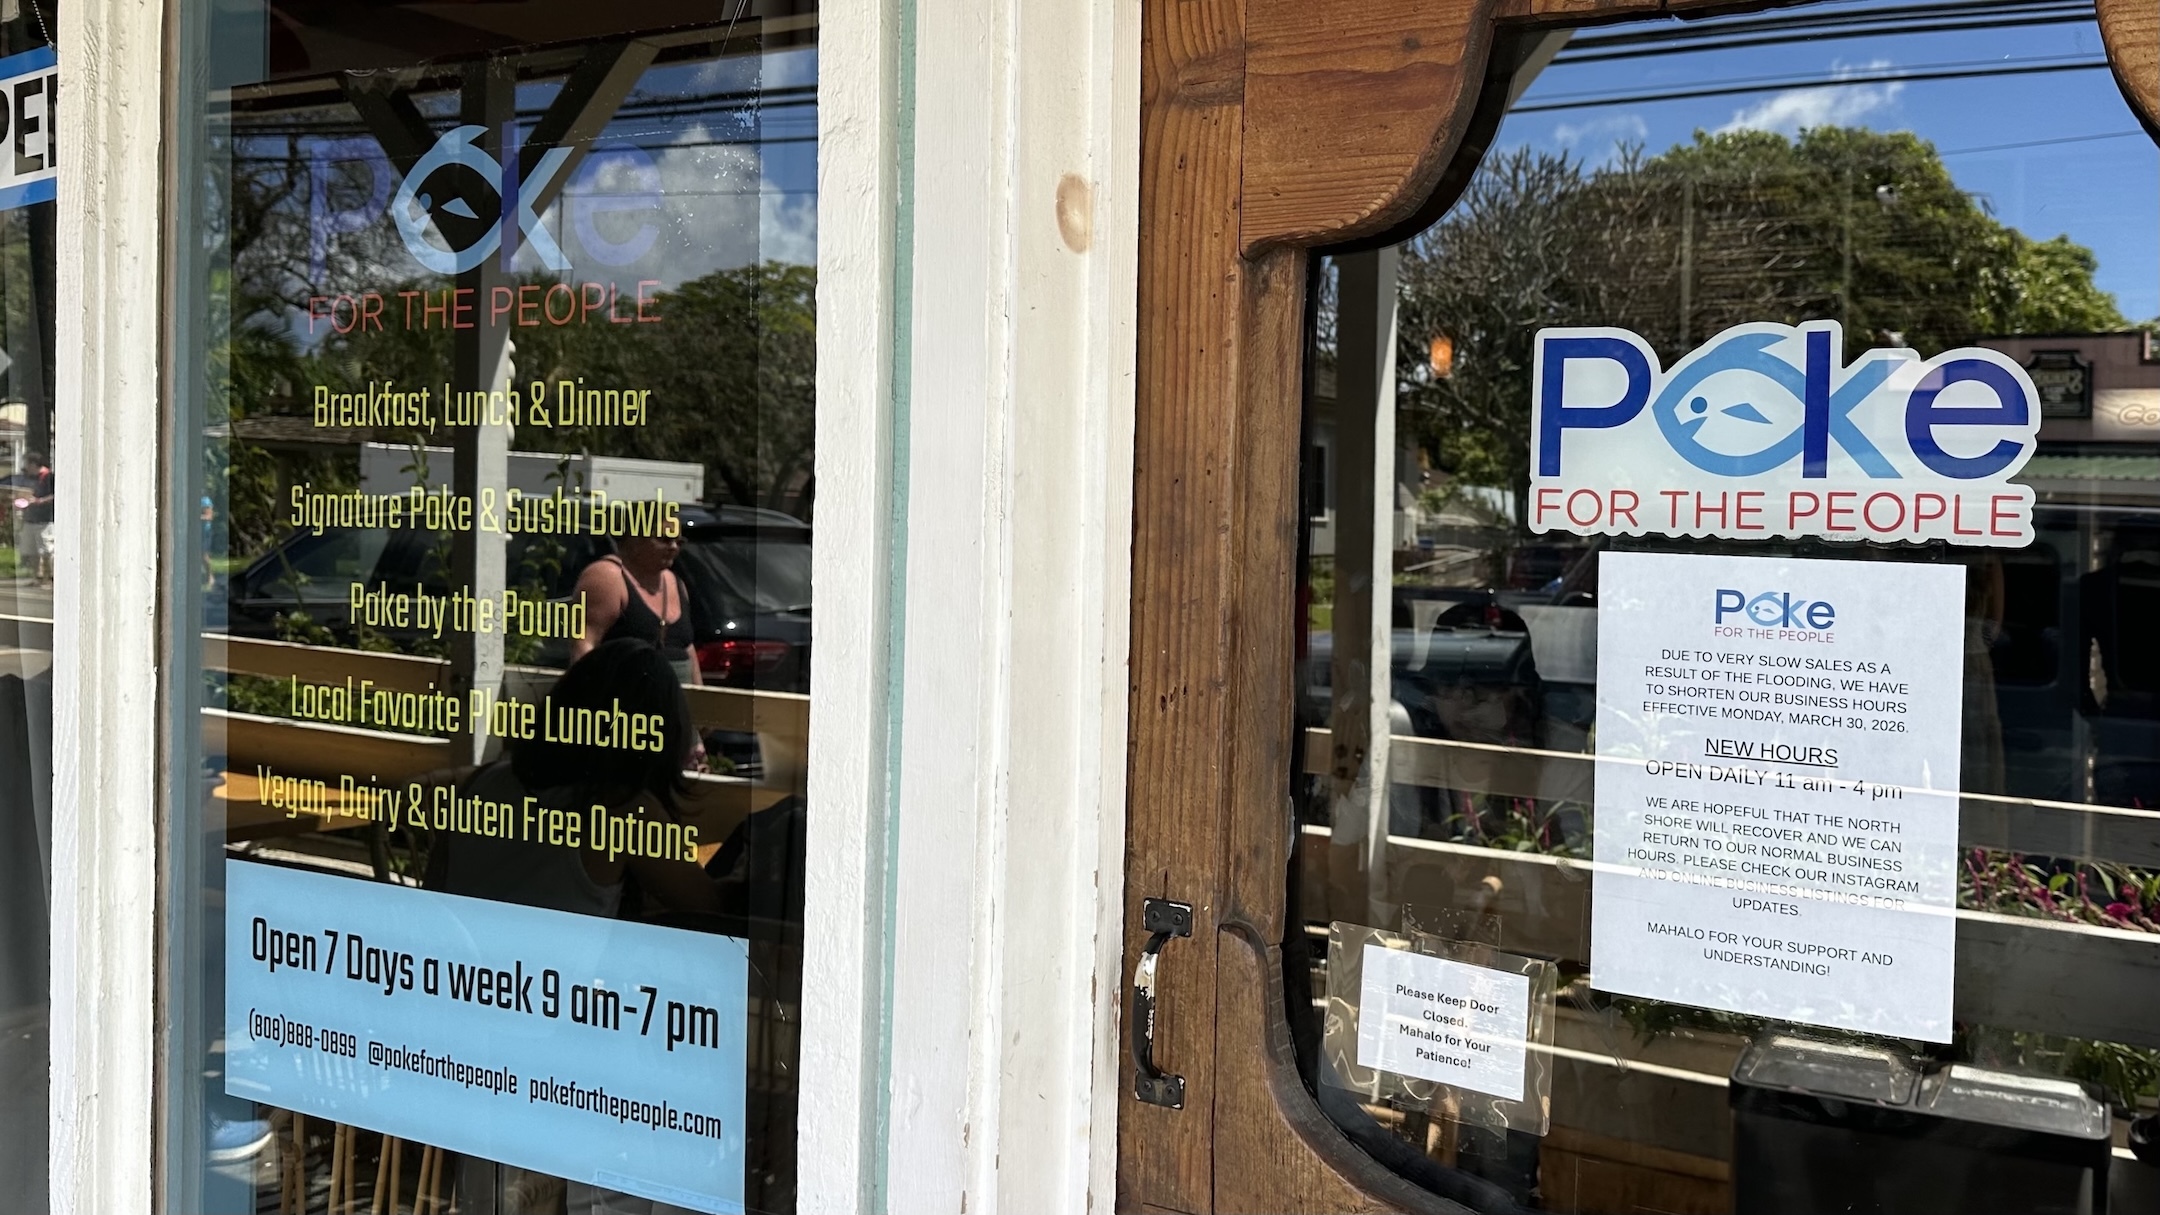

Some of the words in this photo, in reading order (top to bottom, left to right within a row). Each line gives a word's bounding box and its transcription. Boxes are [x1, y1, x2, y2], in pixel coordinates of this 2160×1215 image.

[309, 294, 383, 334] FOR
[398, 289, 474, 329] THE
[491, 280, 662, 326] PEOPLE
[314, 381, 436, 434] Breakfast,
[444, 382, 520, 426] Lunch
[530, 381, 553, 428] &
[558, 378, 651, 426] Dinner
[1539, 331, 2029, 480] Poke
[291, 483, 401, 536] Signature
[411, 485, 471, 531] Poke
[480, 487, 502, 534] &
[507, 485, 579, 535] Sushi
[590, 488, 680, 538] Bowls
[1537, 488, 1639, 527] FOR
[1660, 490, 1765, 530] THE
[1789, 491, 2024, 537] PEOPLE
[350, 581, 409, 627] Poke
[417, 583, 445, 639] by
[452, 585, 494, 633] the
[503, 590, 586, 640] Pound
[1715, 589, 1835, 629] Poke
[1714, 626, 1742, 638] FOR
[1747, 628, 1774, 640] THE
[1779, 630, 1834, 643] PEOPLE
[1645, 666, 1697, 679] RESULT
[1701, 669, 1720, 681] OF
[1725, 671, 1752, 683] THE
[1757, 673, 1836, 691] FLOODING,
[1840, 679, 1864, 692] WE
[1869, 681, 1908, 695] HAVE
[1662, 649, 1690, 661] DUE
[1694, 651, 1712, 663] TO
[1717, 652, 1754, 665] VERY
[1759, 655, 1801, 668] SLOW
[1805, 658, 1852, 672] SALES
[1856, 661, 1876, 674] AS
[1881, 663, 1891, 675] A
[290, 674, 352, 722] Local
[360, 680, 460, 733] Favorite
[469, 688, 535, 741] Plate
[545, 695, 664, 752] Lunches
[1643, 702, 1717, 718] EFFECTIVE
[1721, 708, 1784, 724] MONDAY,
[1789, 712, 1842, 727] MARCH
[1846, 717, 1866, 731] 30,
[1872, 720, 1909, 733] 2026.
[1646, 684, 1664, 694] TO
[1668, 685, 1735, 700] SHORTEN
[1739, 690, 1770, 702] OUR
[1775, 693, 1848, 709] BUSINESS
[1853, 699, 1907, 713] HOURS
[1705, 738, 1754, 758] NEW
[1760, 742, 1838, 765] HOURS
[1646, 760, 1702, 780] OPEN
[1709, 766, 1767, 786] DAILY
[1775, 772, 1796, 789] 11
[1803, 778, 1832, 793] am
[1853, 780, 1865, 795] 4
[1872, 784, 1902, 801] pm
[257, 764, 332, 823] Vegan,
[340, 775, 400, 832] Dairy
[408, 783, 429, 830] &
[433, 784, 514, 839] Gluten
[522, 796, 581, 848] Free
[591, 804, 699, 863] Options
[1644, 814, 1693, 830] SHORE
[1696, 820, 1728, 834] WILL
[1733, 824, 1802, 842] RECOVER
[1806, 833, 1837, 846] AND
[1842, 836, 1866, 849] WE
[1870, 839, 1901, 853] CAN
[1646, 796, 1667, 809] WE
[1671, 799, 1699, 812] ARE
[1704, 802, 1769, 820] HOPEFUL
[1773, 810, 1810, 824] THAT
[1814, 814, 1843, 828] THE
[1848, 817, 1901, 833] NORTH
[1628, 848, 1680, 864] HOURS.
[1684, 855, 1737, 871] PLEASE
[1741, 862, 1791, 878] CHECK
[1795, 869, 1827, 882] OUR
[1832, 873, 1919, 893] INSTAGRAM
[1643, 832, 1699, 848] RETURN
[1703, 838, 1722, 851] TO
[1726, 842, 1757, 856] OUR
[1761, 846, 1822, 863] NORMAL
[1828, 854, 1903, 872] BUSINESS
[1639, 868, 1667, 880] AND
[1671, 871, 1722, 888] ONLINE
[1727, 878, 1798, 898] BUSINESS
[1802, 888, 1868, 907] LISTINGS
[1874, 898, 1905, 911] FOR
[1732, 898, 1802, 916] UPDATES.
[1648, 922, 1704, 940] MAHALO
[1709, 931, 1738, 944] FOR
[1742, 935, 1782, 951] YOUR
[1788, 942, 1858, 961] SUPPORT
[1862, 952, 1893, 966] AND
[1704, 948, 1830, 976] UNDERSTANDING!
[252, 917, 316, 972] Open
[324, 930, 339, 976] 7
[347, 933, 414, 996] Days
[423, 957, 439, 996] a
[448, 960, 534, 1014] week
[542, 970, 560, 1018] 9
[571, 981, 657, 1036] am-7
[667, 1000, 719, 1052] pm
[1396, 984, 1434, 1001] Please
[1437, 993, 1466, 1008] Keep
[1470, 1000, 1500, 1014] Door
[1399, 1024, 1441, 1042] Mahalo
[1445, 1034, 1461, 1046] for
[1465, 1038, 1491, 1053] Your
[1423, 1010, 1468, 1027] Closed.
[249, 1008, 357, 1059] (808)888-0899
[368, 1039, 518, 1097] @pokeforthepeople
[529, 1075, 721, 1140] pokeforthepeople.com
[1416, 1048, 1471, 1068] Patience!
